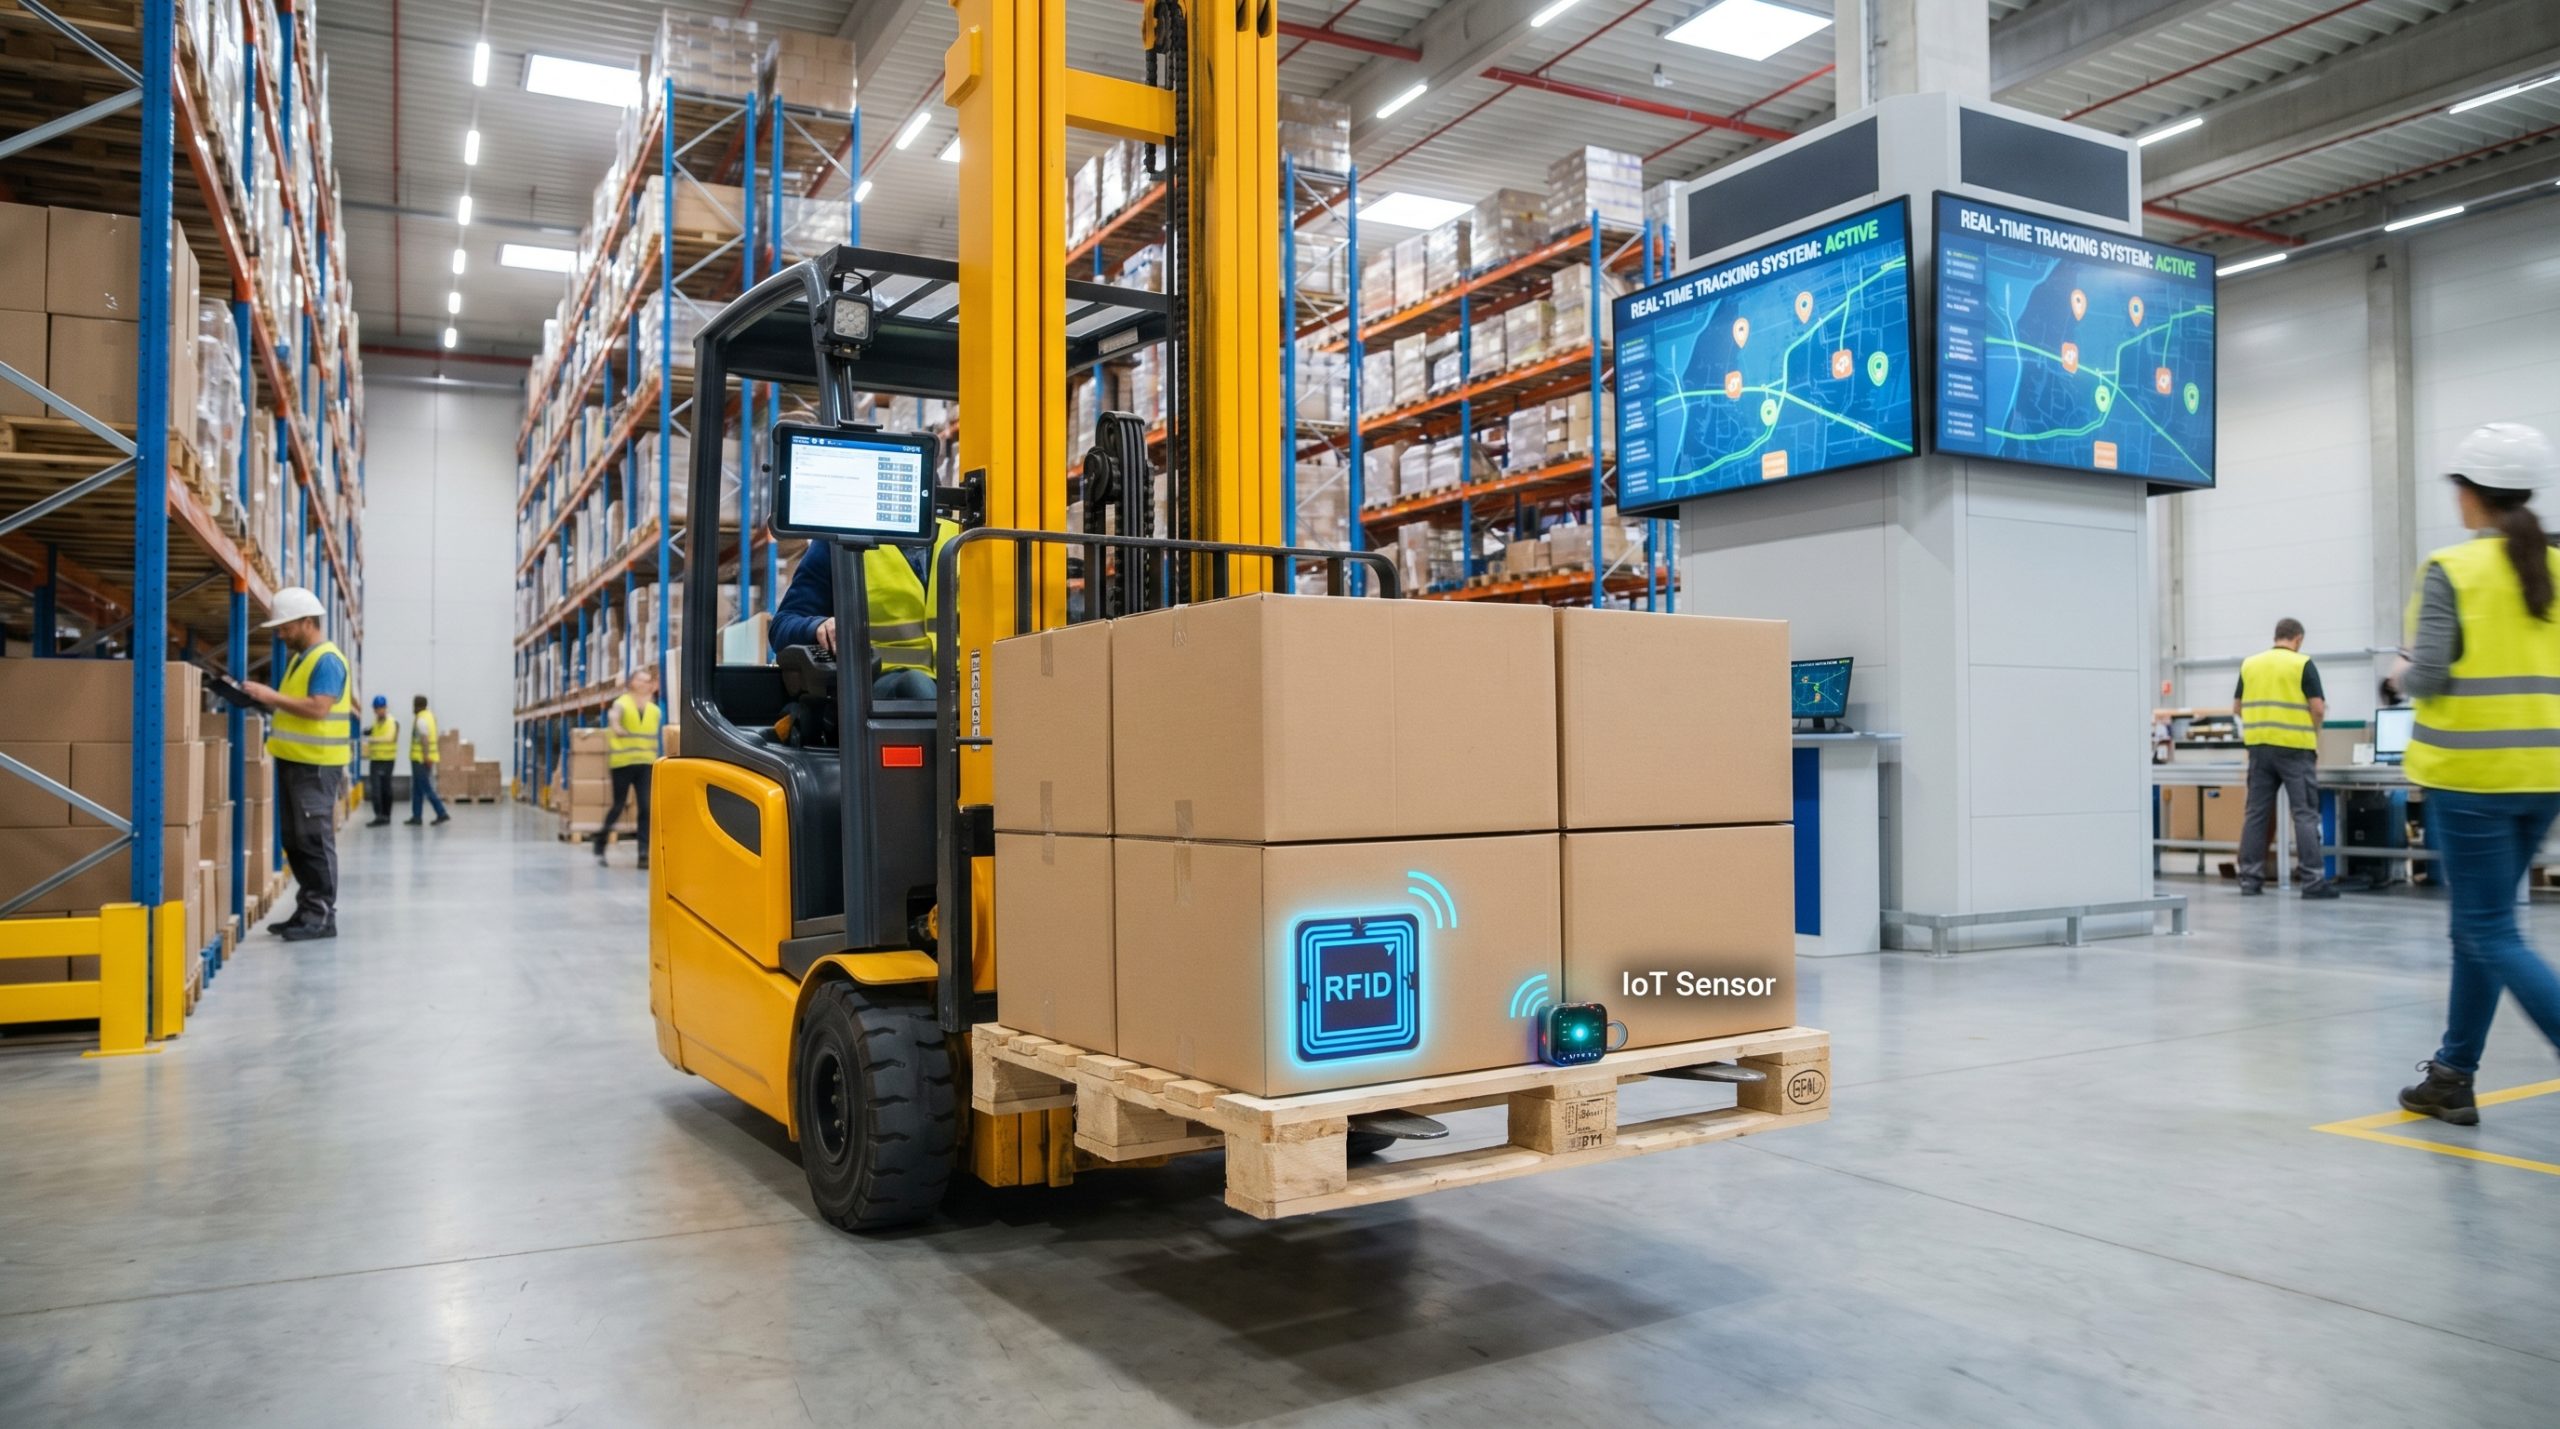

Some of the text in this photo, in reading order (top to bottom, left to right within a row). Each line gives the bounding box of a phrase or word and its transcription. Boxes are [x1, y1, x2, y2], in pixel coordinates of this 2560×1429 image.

[1631, 219, 1879, 319] REAL-TIME TRACKING SYSTEM: ACTIVE
[1960, 209, 2197, 279] REAL-TIME TRACKING SYSTEM: ACTIVE
[1325, 971, 1392, 1002] RFID
